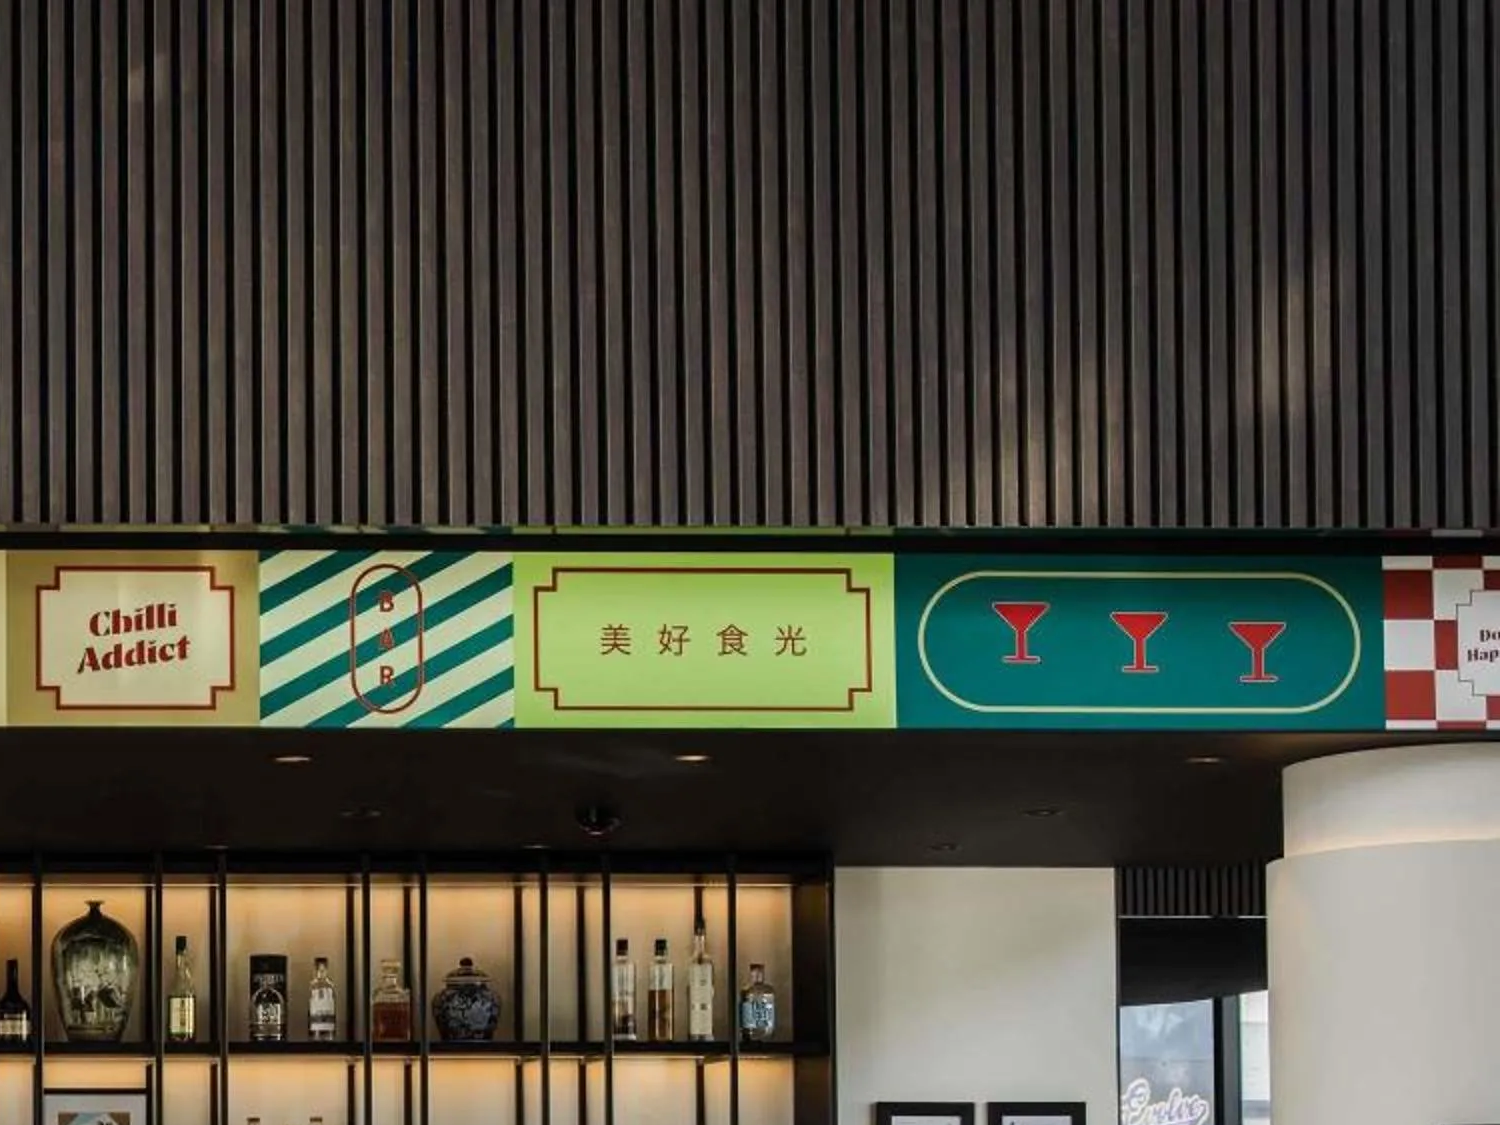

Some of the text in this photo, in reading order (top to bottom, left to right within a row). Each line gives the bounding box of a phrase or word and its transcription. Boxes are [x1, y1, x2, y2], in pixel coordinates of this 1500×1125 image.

[89, 602, 177, 637] Chilli
[77, 635, 190, 673] Addict
[379, 591, 394, 686] BAR
[600, 624, 807, 657] 美好食光
